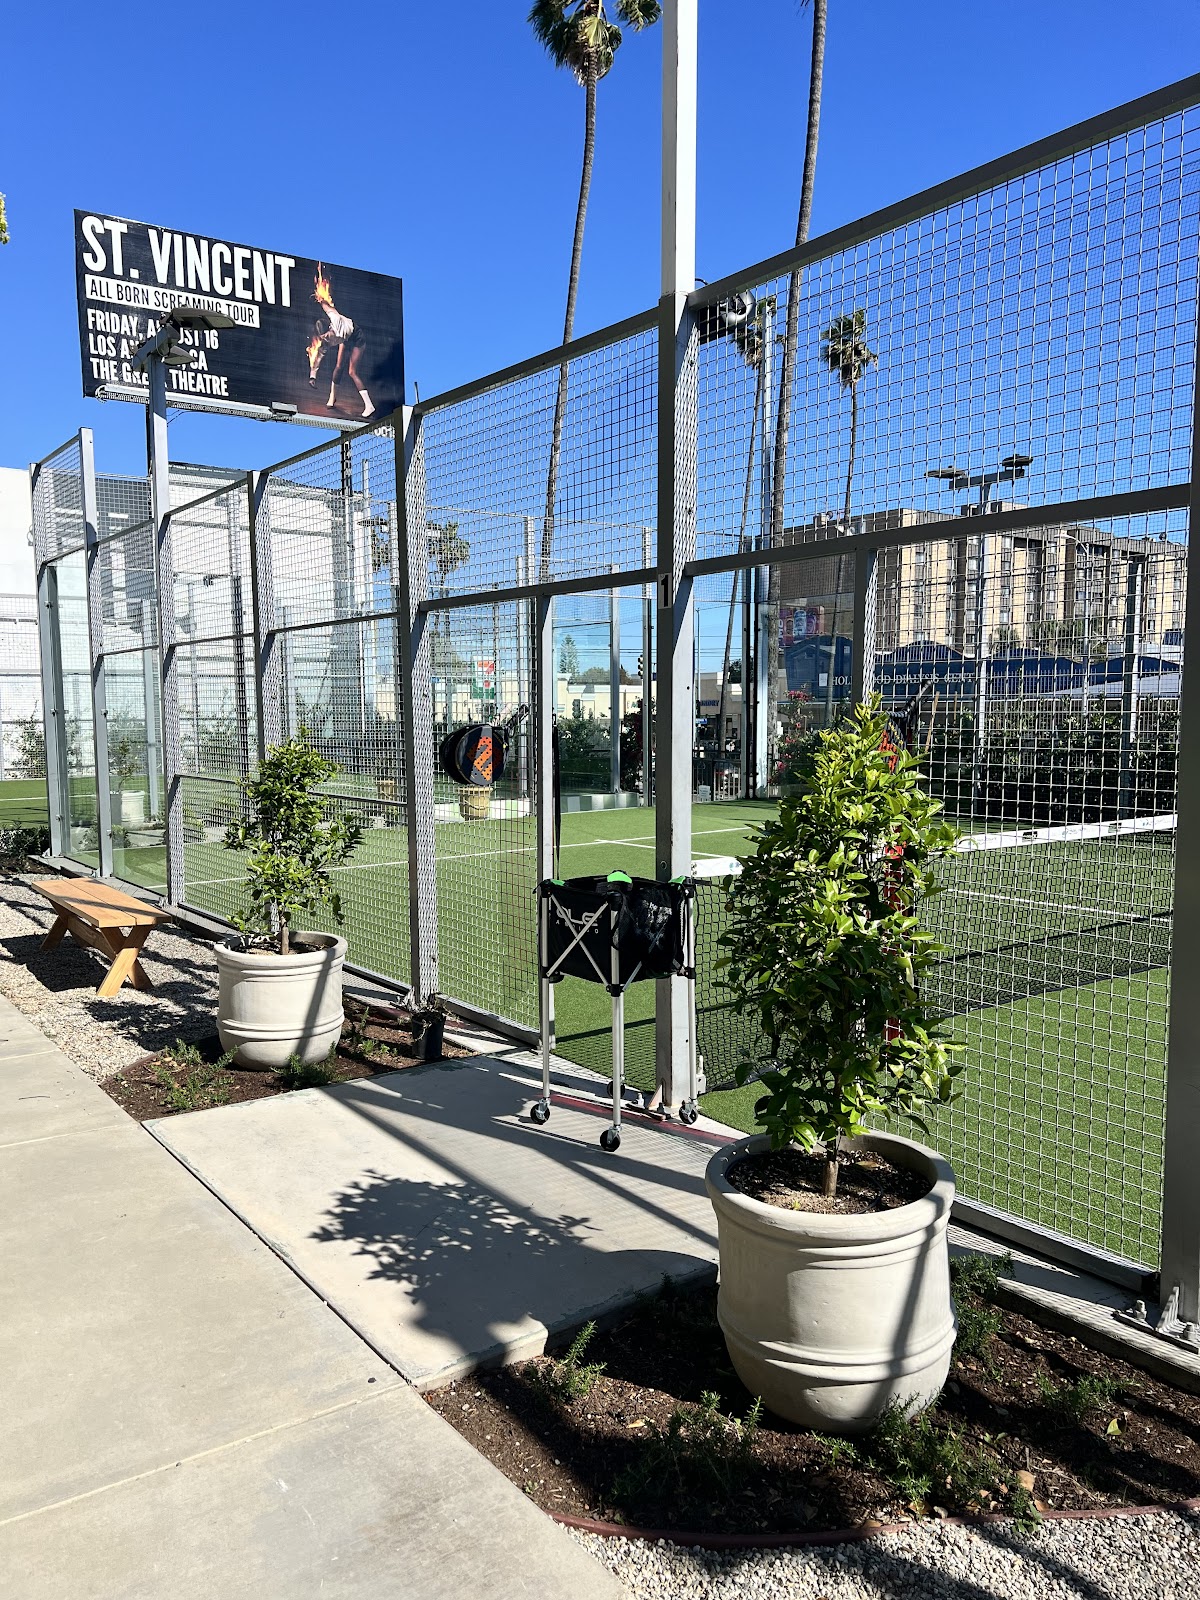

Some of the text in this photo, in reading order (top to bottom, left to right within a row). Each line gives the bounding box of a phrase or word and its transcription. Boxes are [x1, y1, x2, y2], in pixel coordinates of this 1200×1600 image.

[82, 216, 295, 308] ST. VINCENT
[90, 279, 113, 299] ALL
[116, 283, 149, 306] BORN
[226, 303, 255, 325] TOUR
[87, 308, 143, 341] FRIDAY,
[203, 328, 219, 350] 16
[88, 333, 117, 360] LOS
[188, 349, 208, 372] CA
[89, 357, 119, 382] THE
[169, 368, 229, 397] THEATRE
[661, 574, 669, 607] 1
